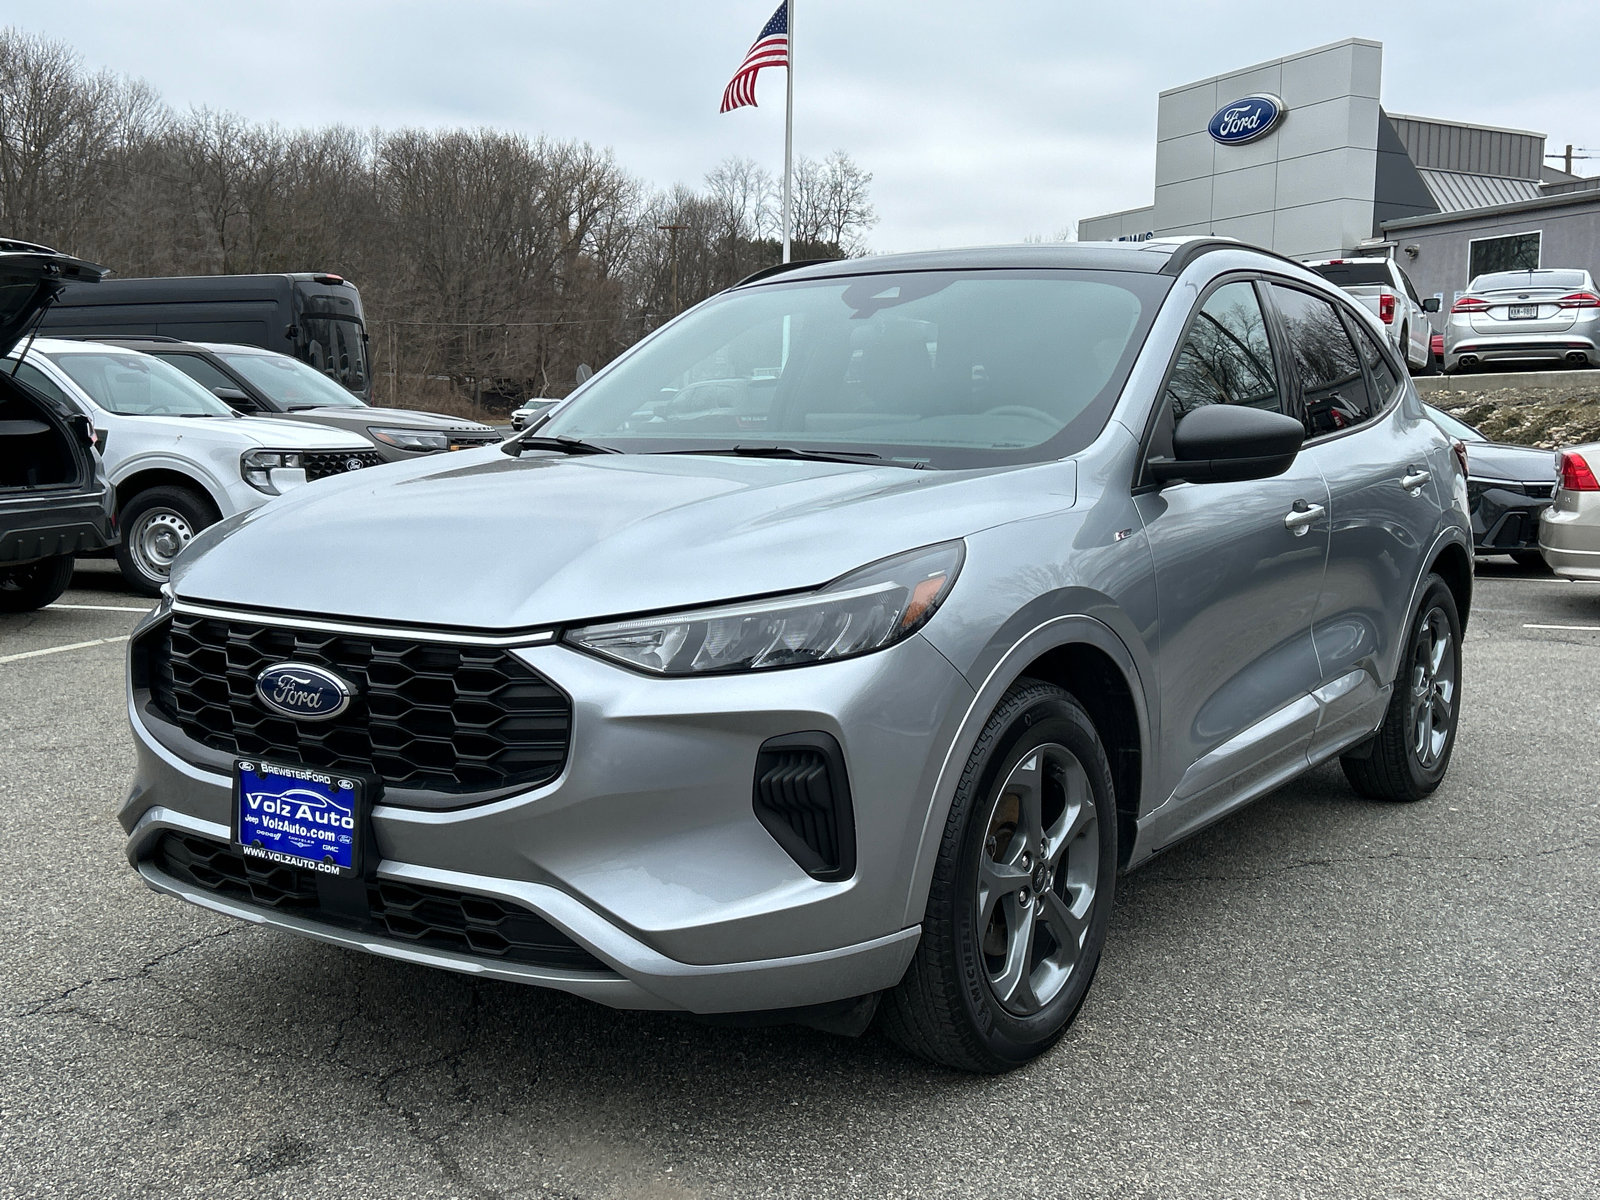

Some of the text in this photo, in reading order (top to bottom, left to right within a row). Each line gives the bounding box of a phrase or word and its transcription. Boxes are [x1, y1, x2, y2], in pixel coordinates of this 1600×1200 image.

[1220, 105, 1261, 136] Ford
[273, 674, 324, 709] Ford
[246, 793, 354, 829] Volz Auto
[244, 814, 336, 842] Jeep VolzAuto.com
[243, 846, 340, 875] WWW.VOLZAUTO.COM
[322, 844, 339, 853] GMC
